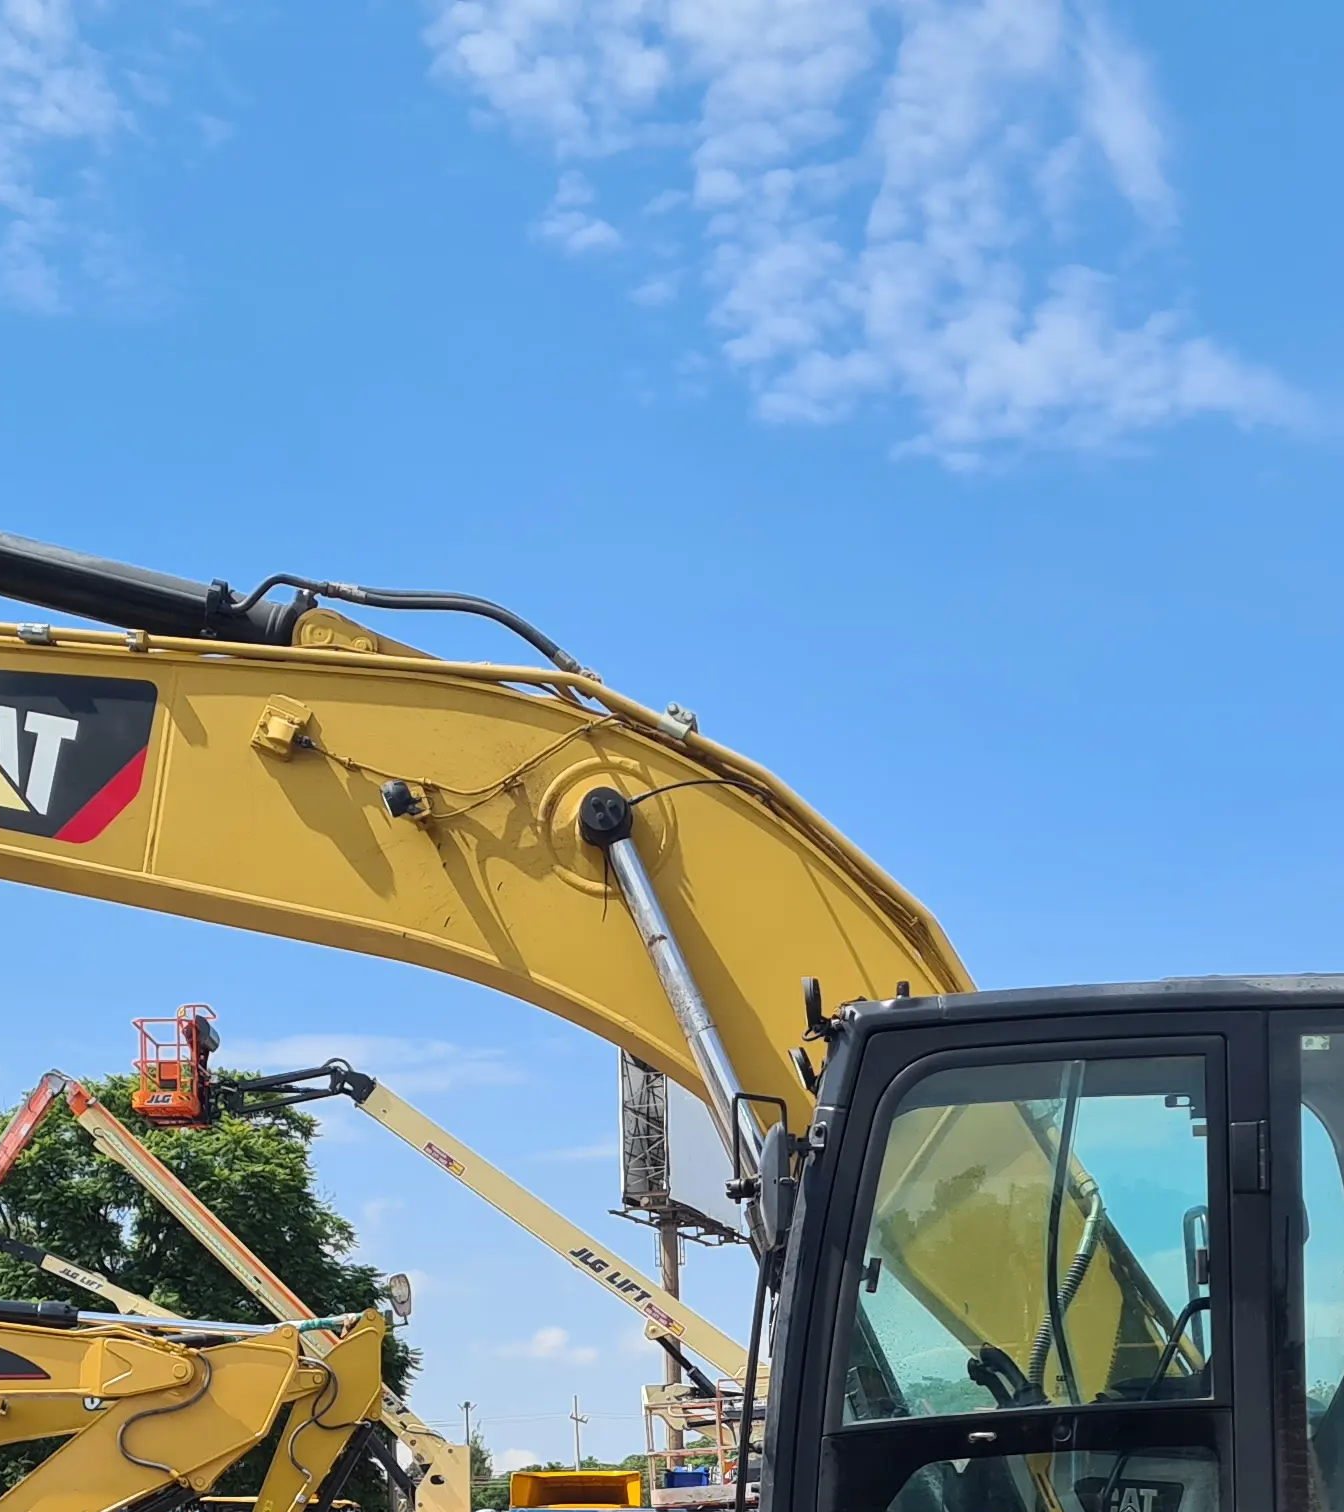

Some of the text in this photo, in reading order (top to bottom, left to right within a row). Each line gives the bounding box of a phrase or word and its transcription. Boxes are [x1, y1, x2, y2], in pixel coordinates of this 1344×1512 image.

[146, 1094, 173, 1104] JLG
[59, 1268, 104, 1290] JLG LIFT
[569, 1248, 652, 1302] JLG LIFT
